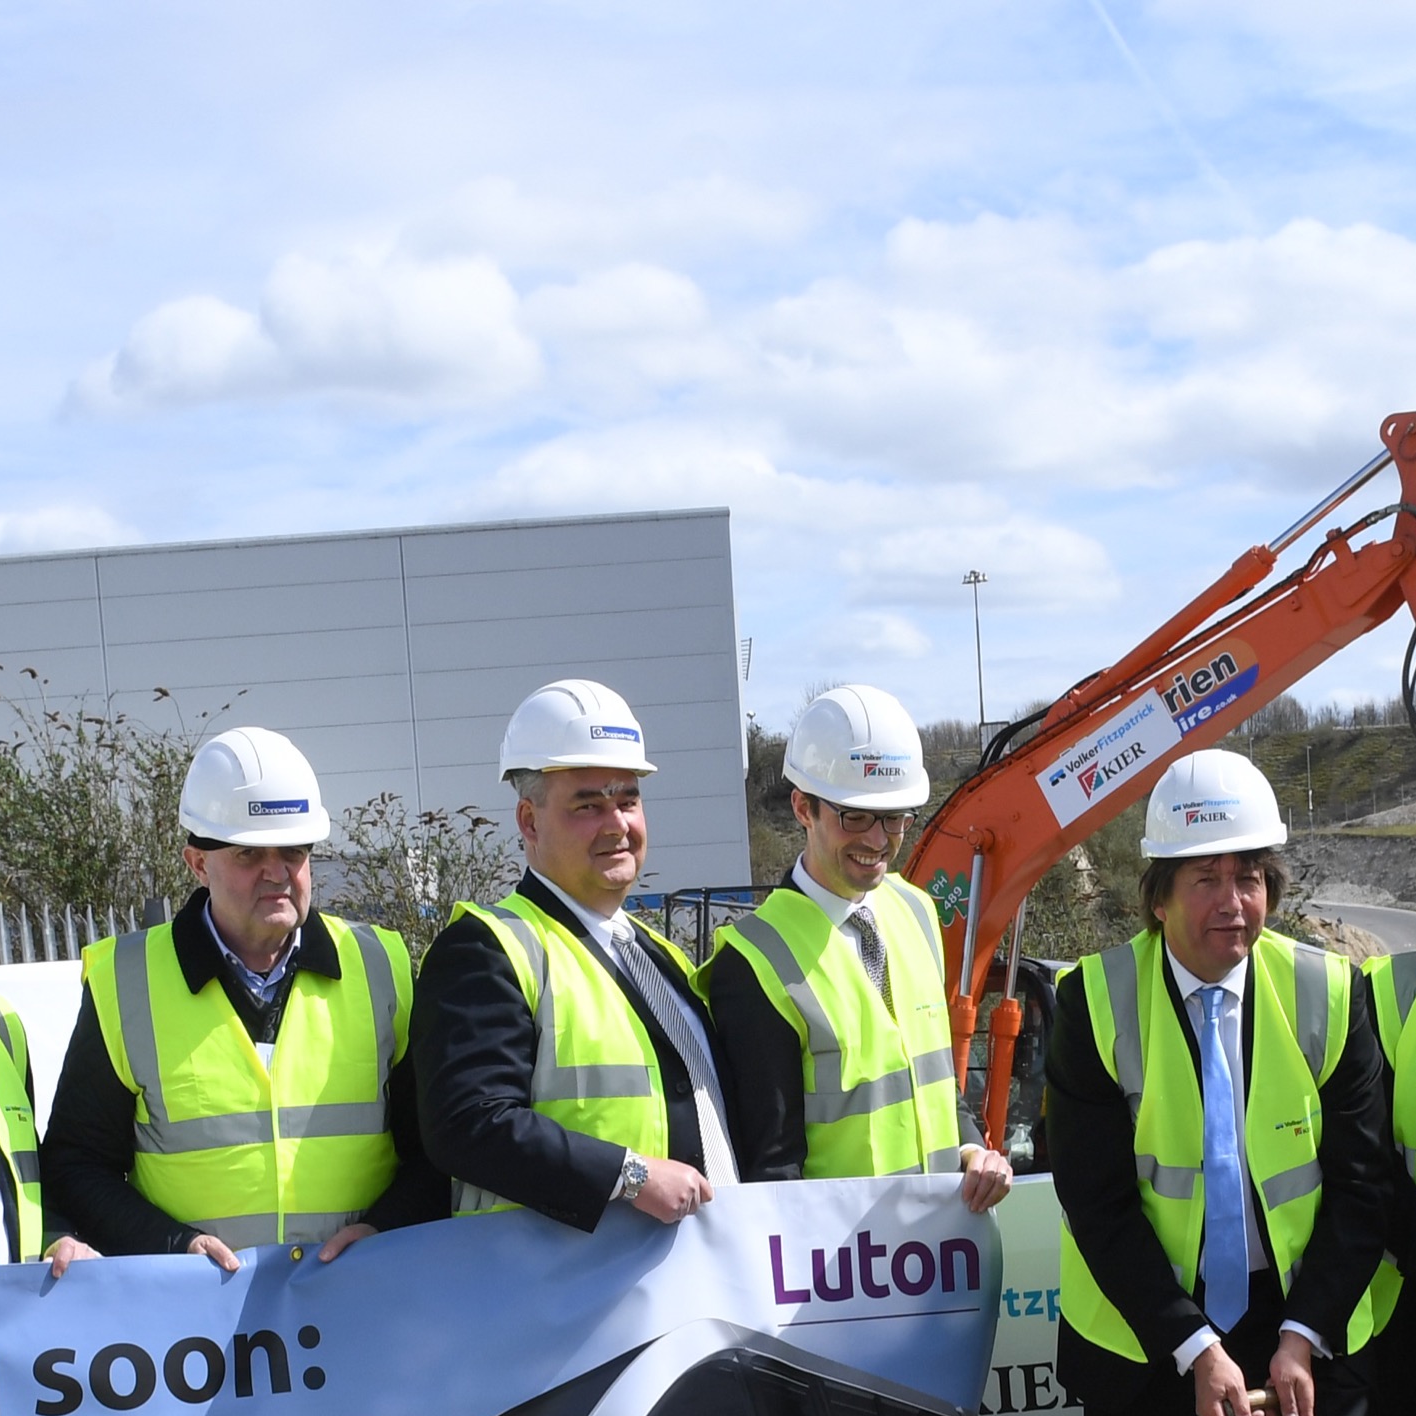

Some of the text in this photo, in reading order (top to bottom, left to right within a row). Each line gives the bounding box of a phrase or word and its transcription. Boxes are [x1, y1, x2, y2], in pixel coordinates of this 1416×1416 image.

[1065, 702, 1156, 774] VolkerFitzpatrick
[877, 767, 900, 777] KIER
[1101, 741, 1147, 782] KIER
[1200, 811, 1227, 823] KIER
[932, 876, 948, 895] PH
[944, 886, 963, 910] 489
[769, 1230, 980, 1305] Luton
[33, 1325, 326, 1416] soon:
